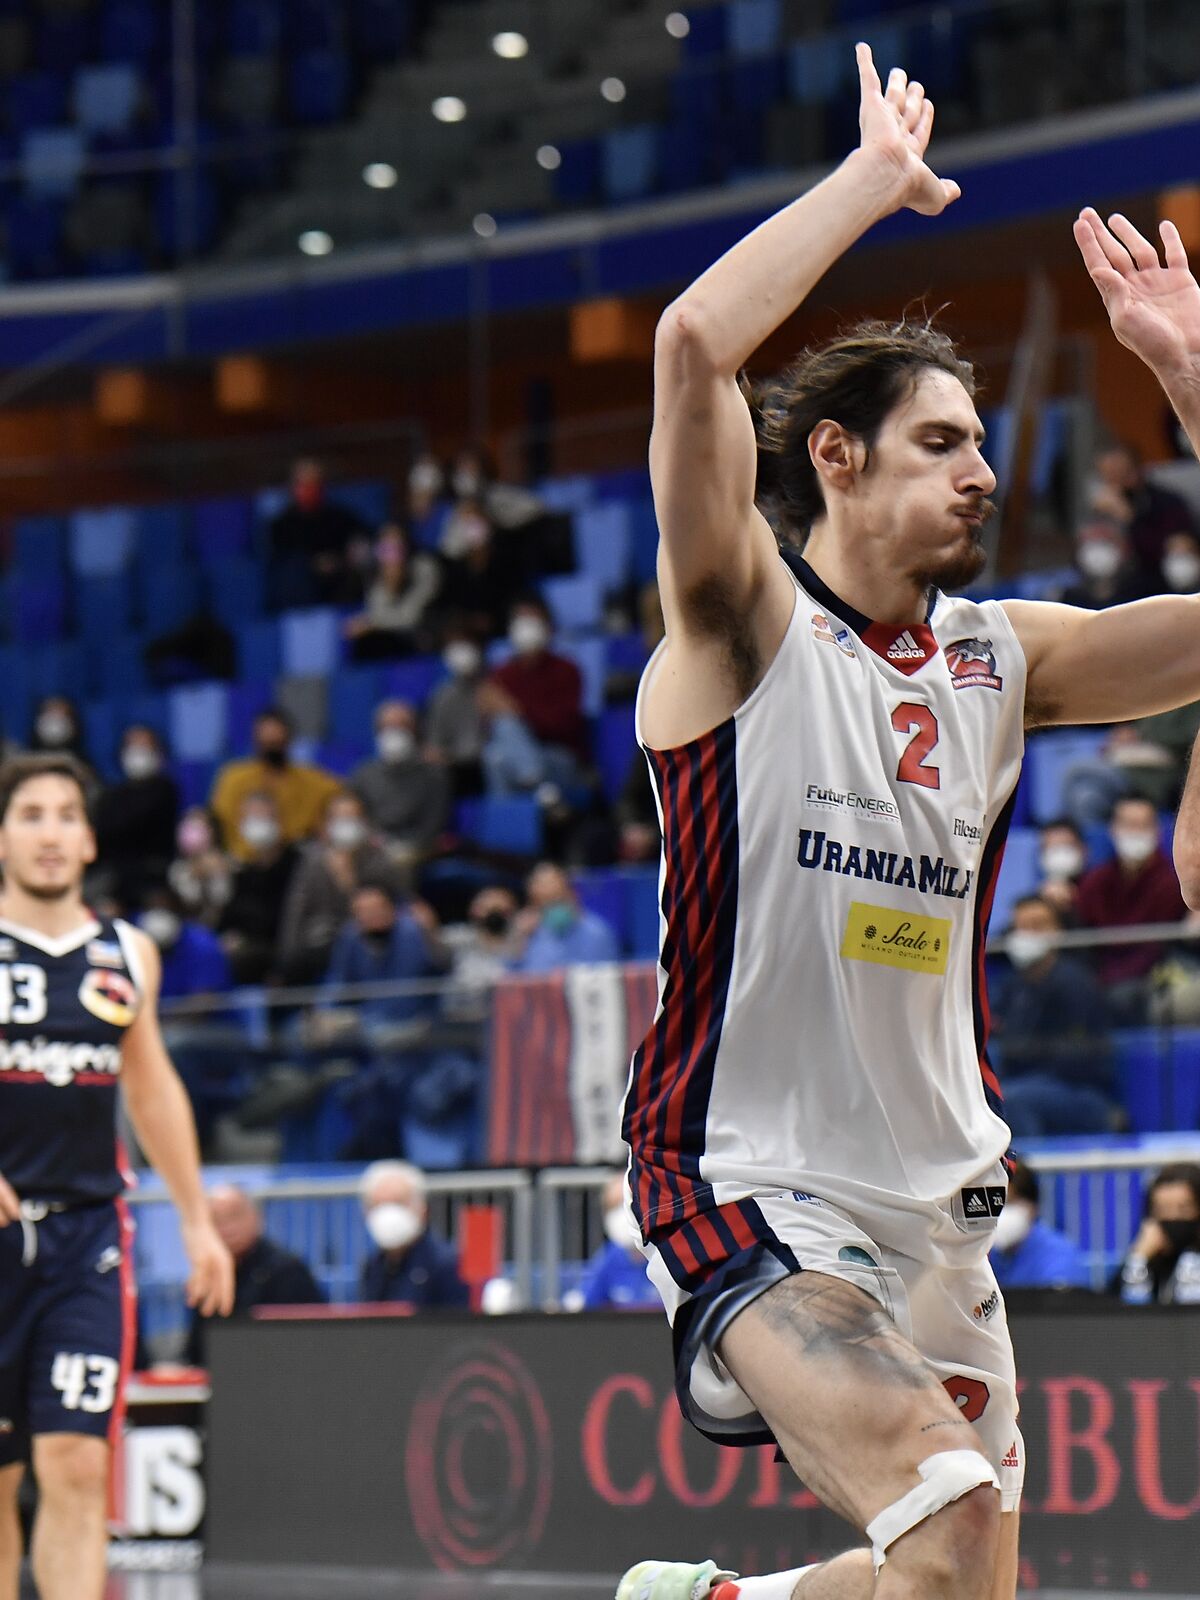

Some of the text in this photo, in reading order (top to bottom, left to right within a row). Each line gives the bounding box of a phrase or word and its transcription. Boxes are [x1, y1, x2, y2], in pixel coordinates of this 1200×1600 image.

[886, 648, 926, 660] adidas
[891, 701, 940, 790] 2
[882, 922, 929, 951] Scalo
[51, 1352, 119, 1413] 43
